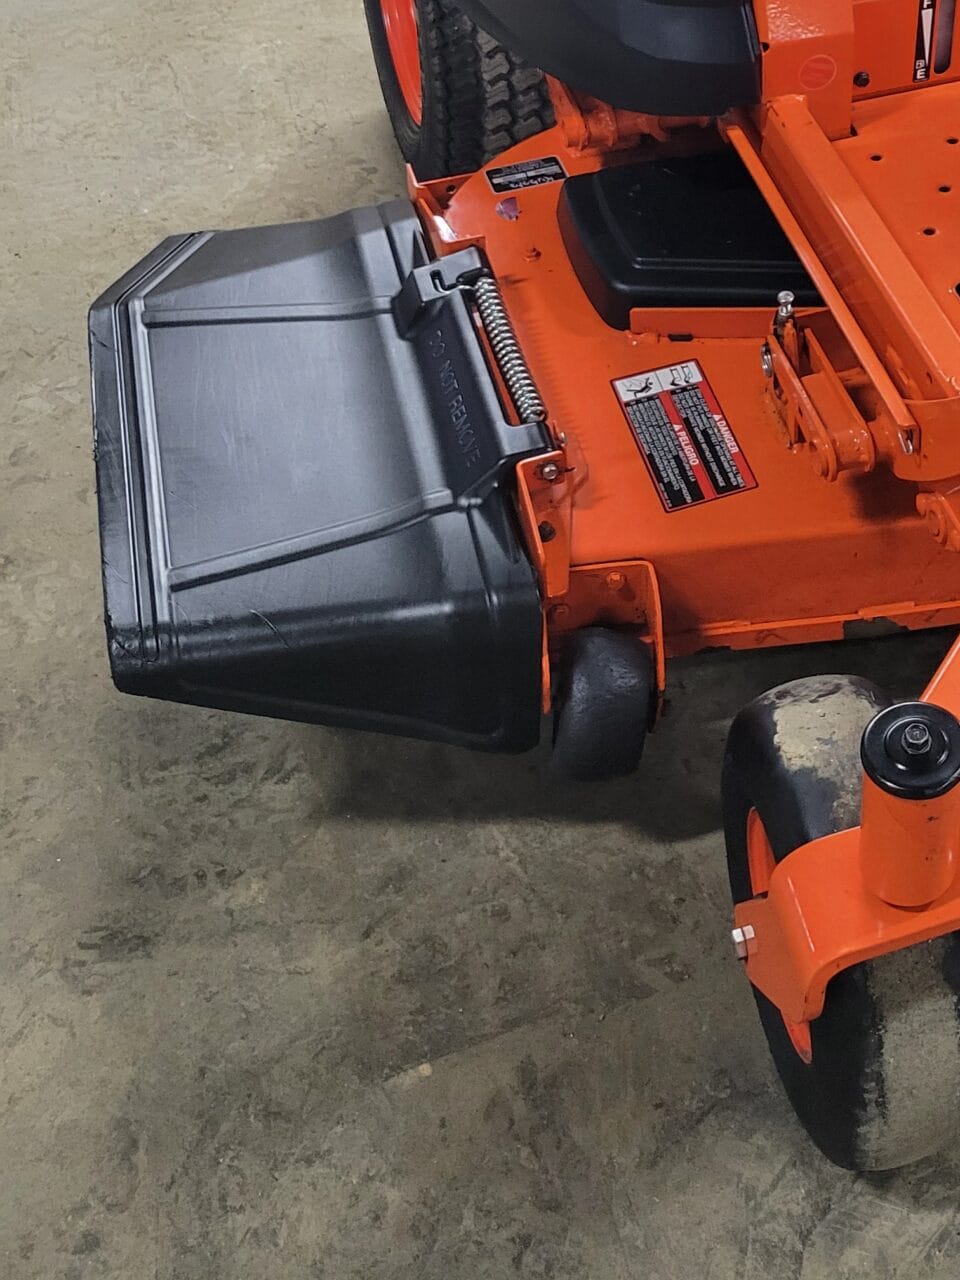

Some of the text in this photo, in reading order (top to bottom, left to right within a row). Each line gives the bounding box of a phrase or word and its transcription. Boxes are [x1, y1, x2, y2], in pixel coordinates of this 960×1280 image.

[916, 68, 926, 79] E
[438, 358, 460, 394] NOT
[447, 392, 482, 468] REMOVE
[676, 430, 698, 465] PELIGRO
[716, 420, 739, 453] DANGER
